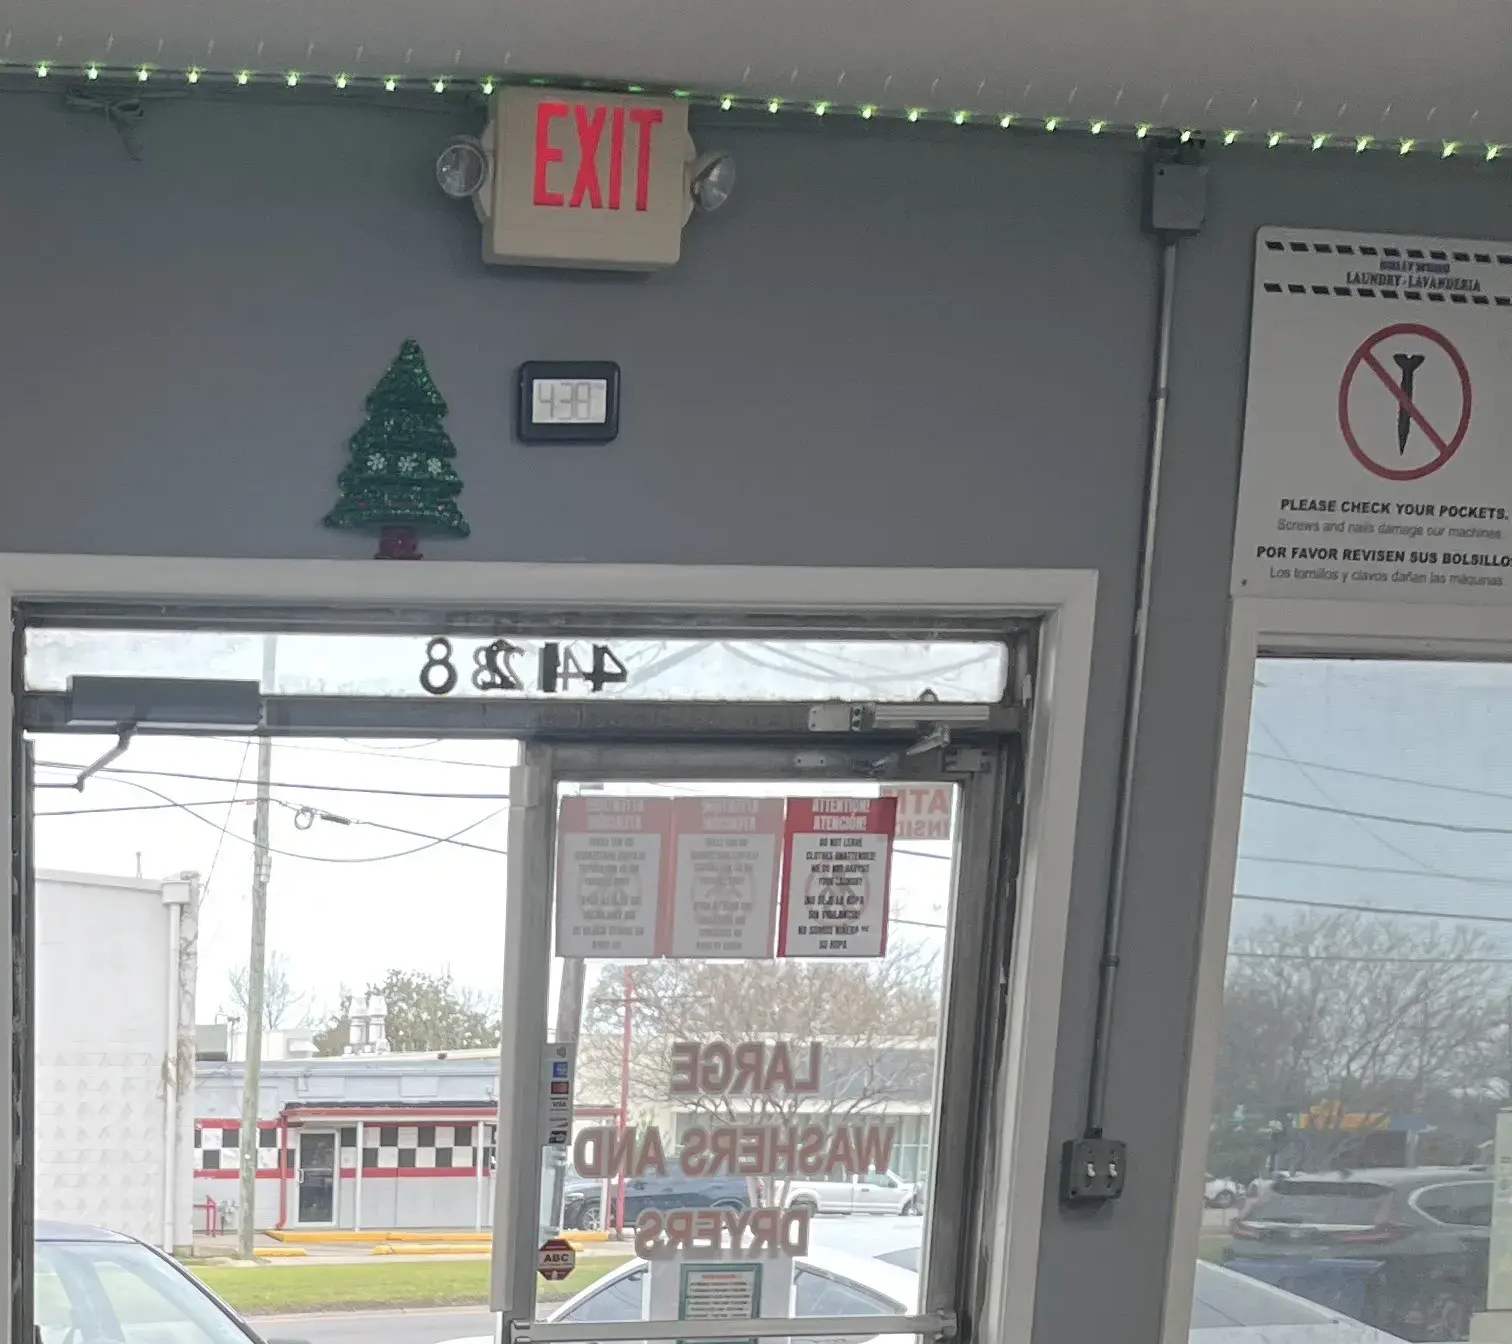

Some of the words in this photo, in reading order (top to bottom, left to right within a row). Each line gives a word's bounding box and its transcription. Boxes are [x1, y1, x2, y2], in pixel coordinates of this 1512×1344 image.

[533, 101, 663, 212] EXIT
[1347, 272, 1402, 286] LAUNDRY
[1408, 274, 1481, 292] LAVANDERIA
[1281, 499, 1337, 512] PLEASE
[1341, 501, 1391, 514] CHECK
[1396, 503, 1434, 516] YOUR
[1439, 504, 1509, 520] POCKETS.
[1278, 518, 1319, 532] Screws
[1323, 520, 1345, 533] and
[1347, 521, 1374, 534] nails
[1378, 523, 1423, 538] damage
[1426, 527, 1444, 537] our
[1256, 546, 1286, 558] POR
[1291, 547, 1338, 561] FAVOR
[1342, 549, 1404, 562] REVISEN
[1410, 551, 1438, 564] SUS
[1270, 567, 1291, 580] Los
[1294, 567, 1339, 580] tornillos
[1342, 571, 1348, 583] y
[1351, 570, 1387, 582] clavos
[1430, 572, 1446, 584] las
[543, 1253, 569, 1262] ABC
